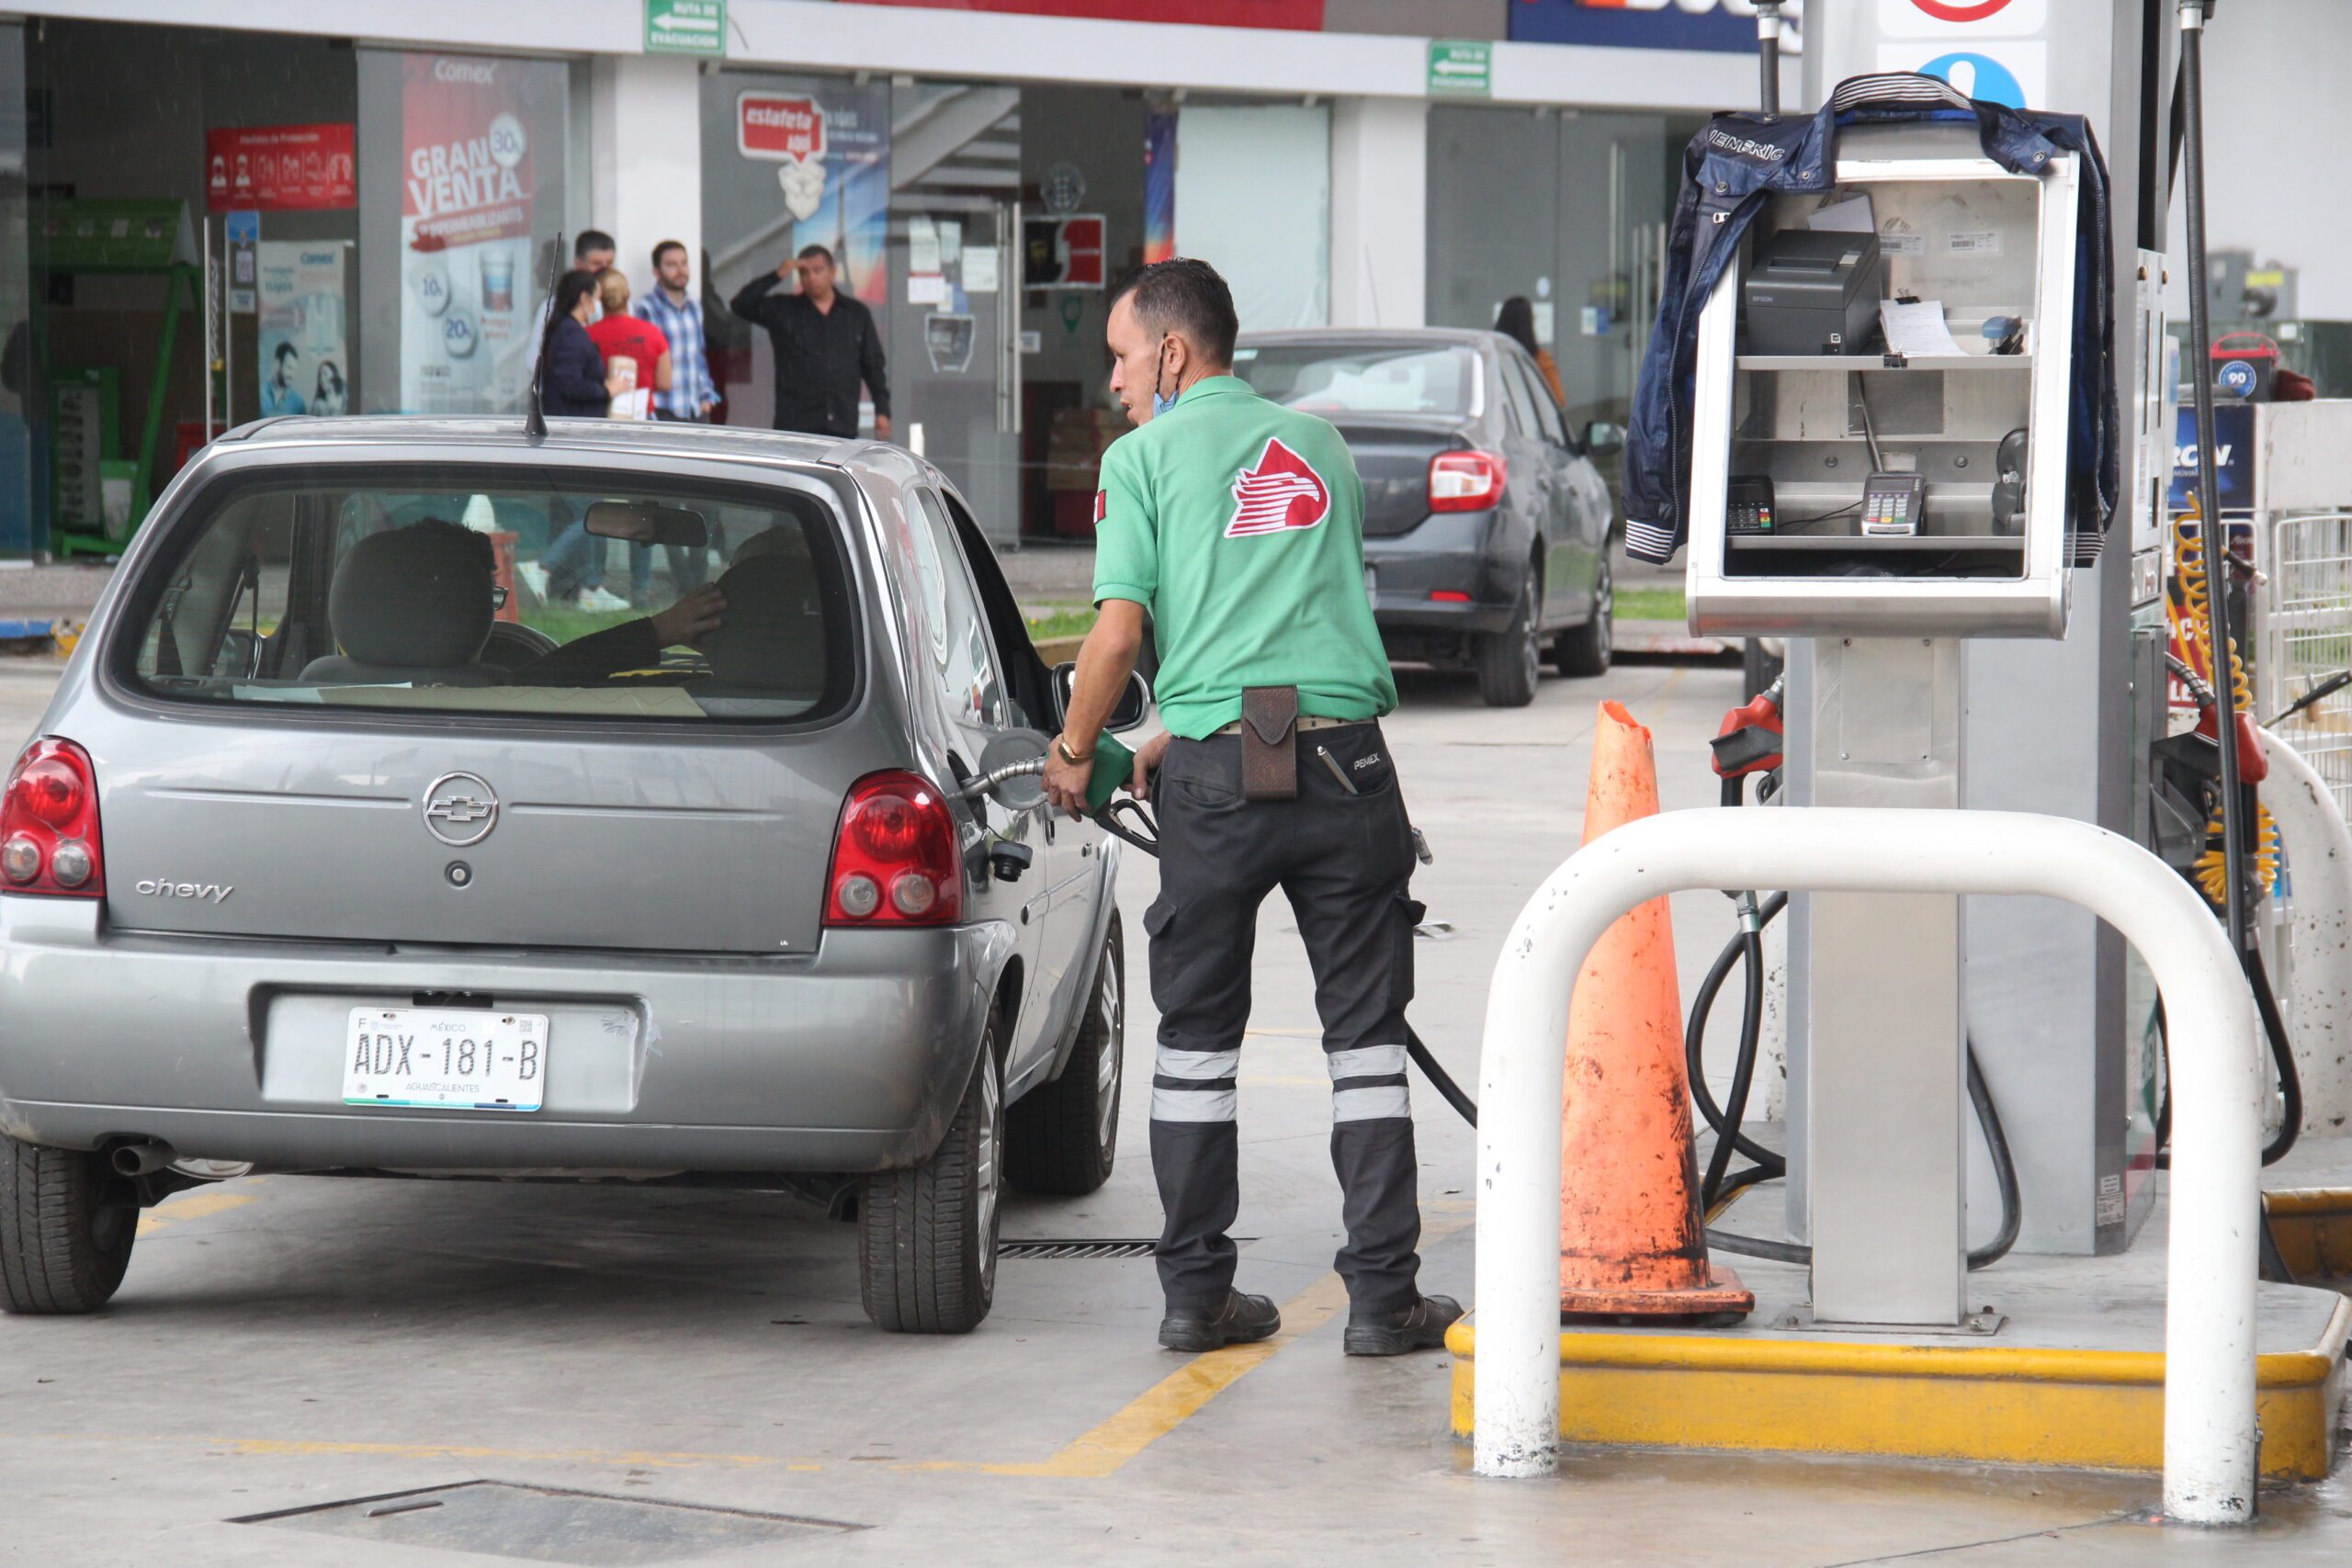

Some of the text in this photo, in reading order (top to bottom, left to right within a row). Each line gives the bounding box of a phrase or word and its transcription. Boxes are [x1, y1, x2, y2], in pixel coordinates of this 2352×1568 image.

[435, 60, 498, 85] Comex
[746, 107, 812, 131] estafeta
[411, 137, 489, 179] GRAN
[408, 165, 523, 218] VENTA
[2228, 372, 2246, 384] 90
[1353, 752, 1380, 770] PEMEX
[135, 878, 234, 904] chevy
[430, 1021, 466, 1032] MÉXICO
[354, 1033, 537, 1080] ADX-181-B
[406, 1082, 480, 1093] AGUASCALIENTES
